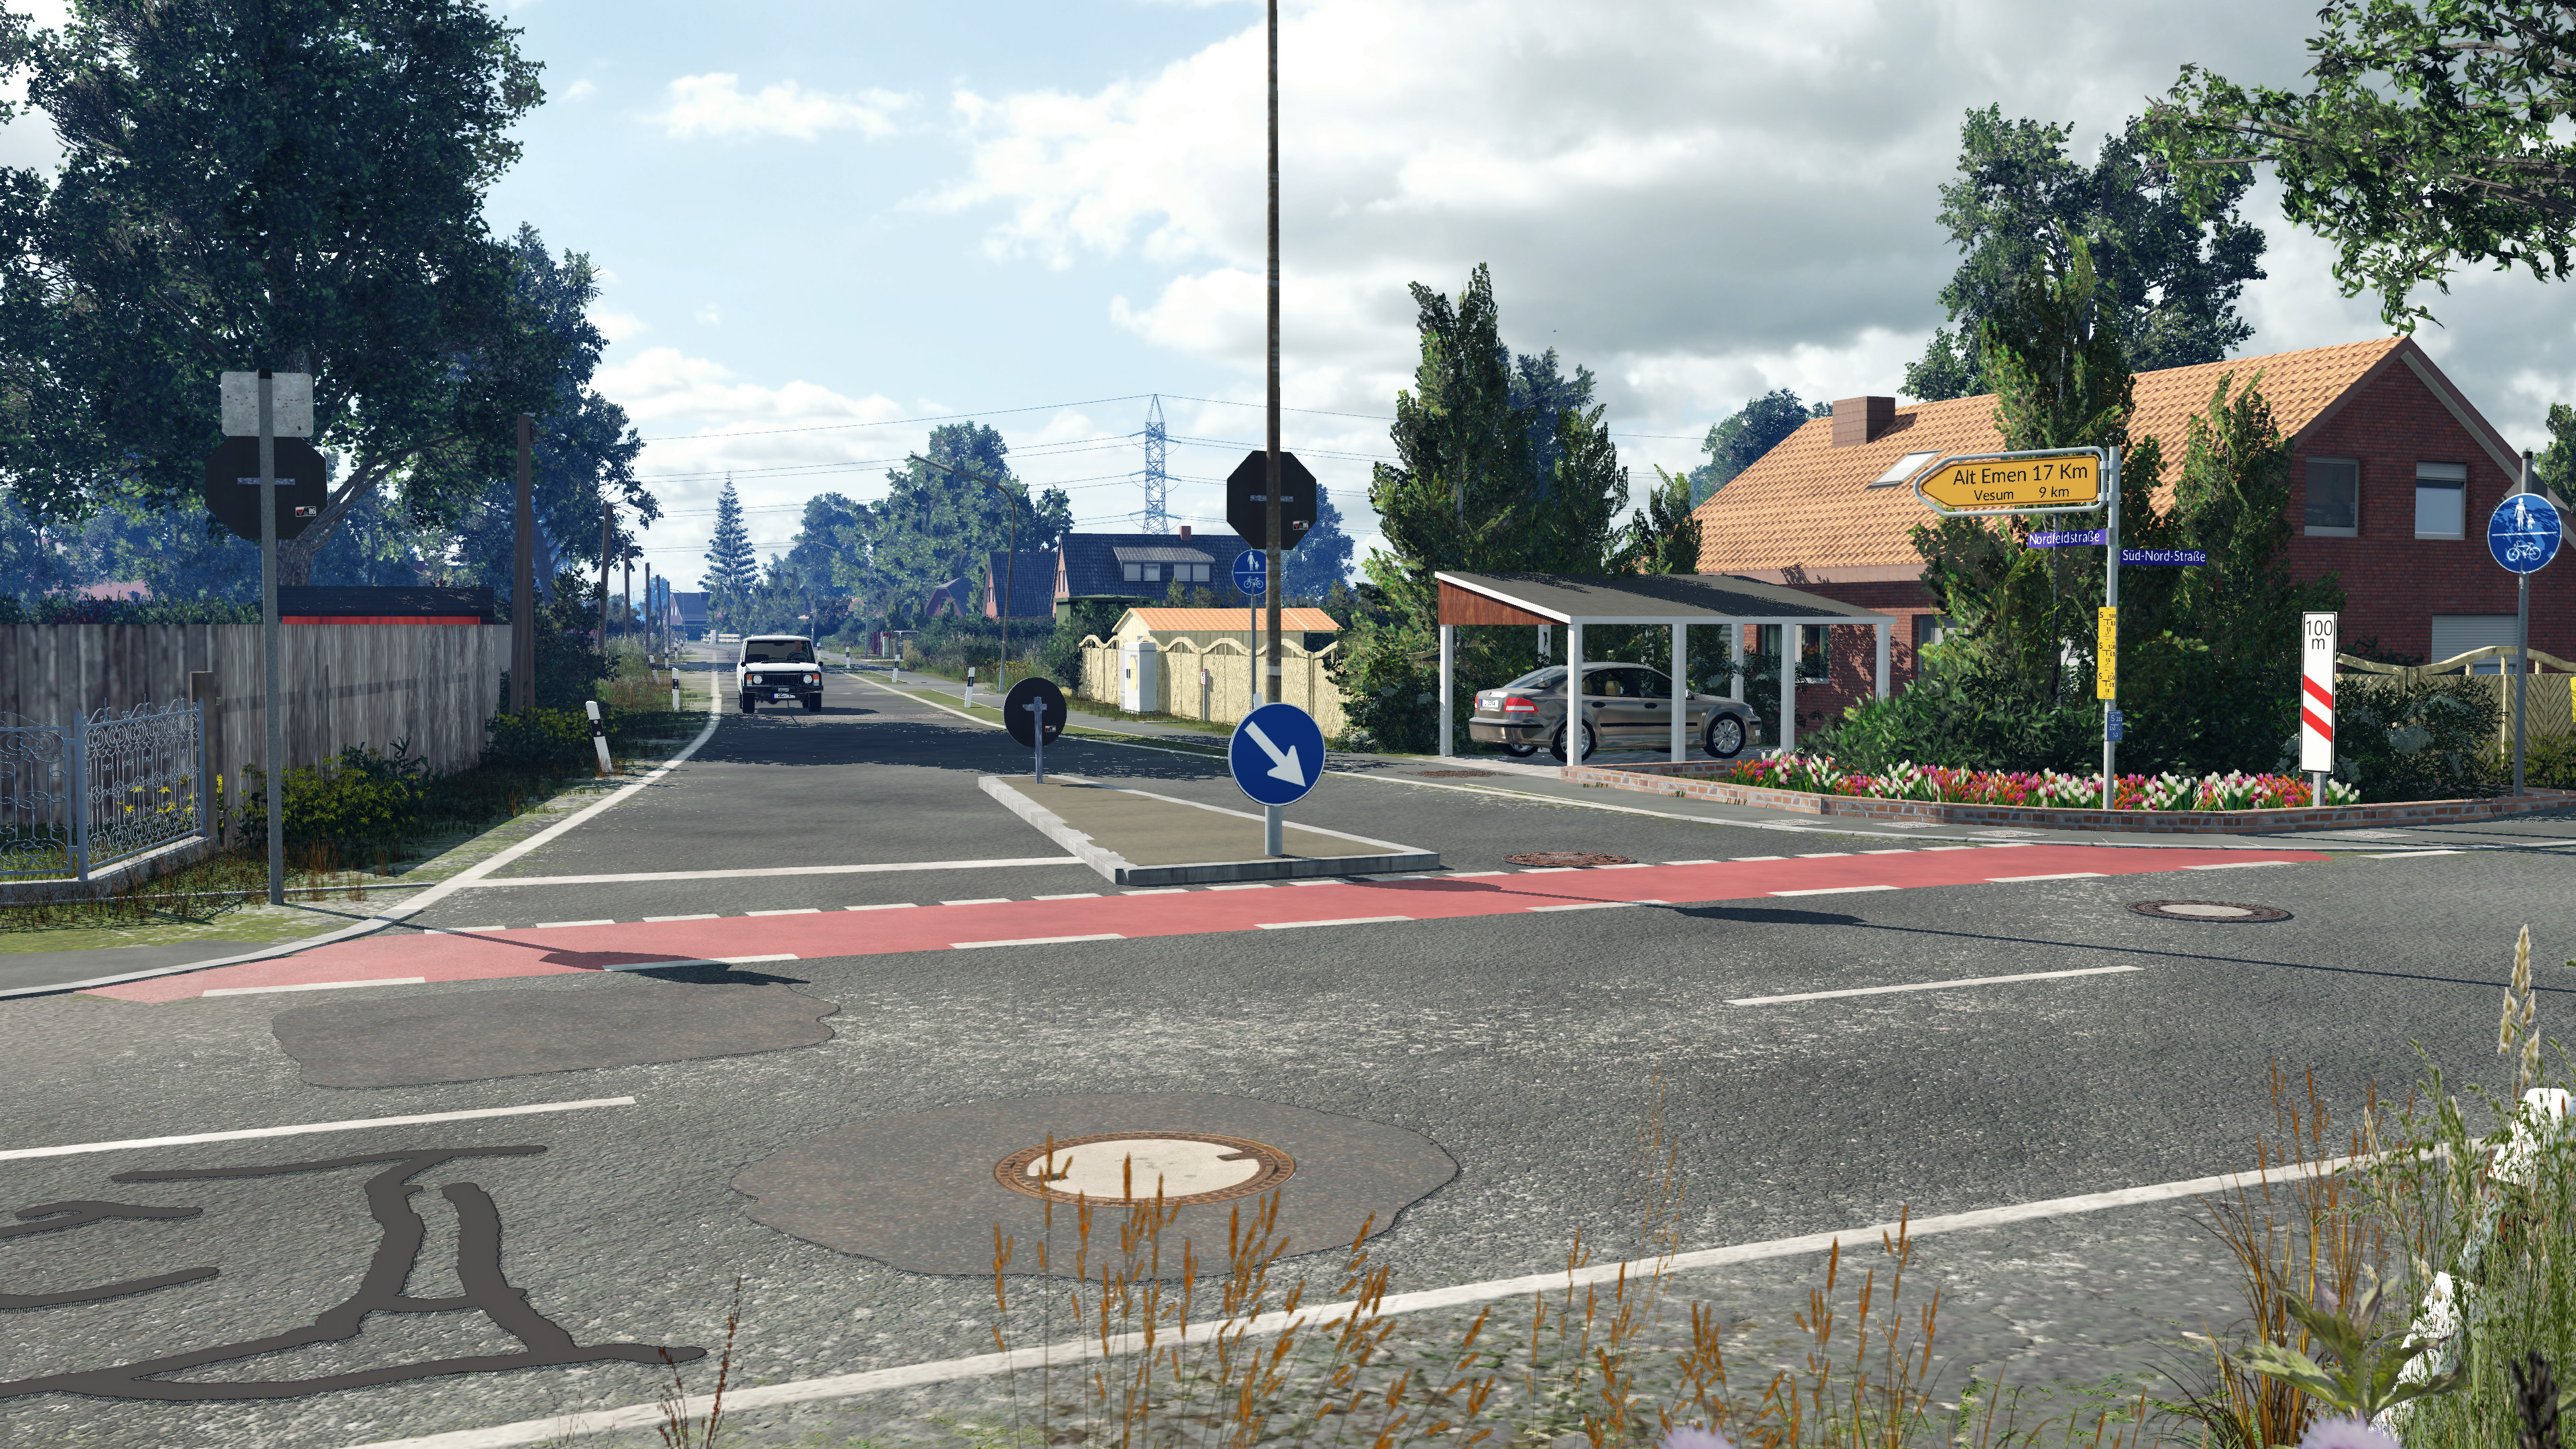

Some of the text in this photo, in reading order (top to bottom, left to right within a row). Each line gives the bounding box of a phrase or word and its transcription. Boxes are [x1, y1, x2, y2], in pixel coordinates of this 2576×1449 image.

[1953, 463, 2088, 485] Alt Emen 17 Km
[1974, 486, 2070, 501] Vesum 9 km
[2029, 530, 2100, 545] Nordfeldstraße
[2123, 549, 2206, 562] Süd-Nord-Straße
[2305, 620, 2333, 637] 100
[2312, 637, 2325, 650] m
